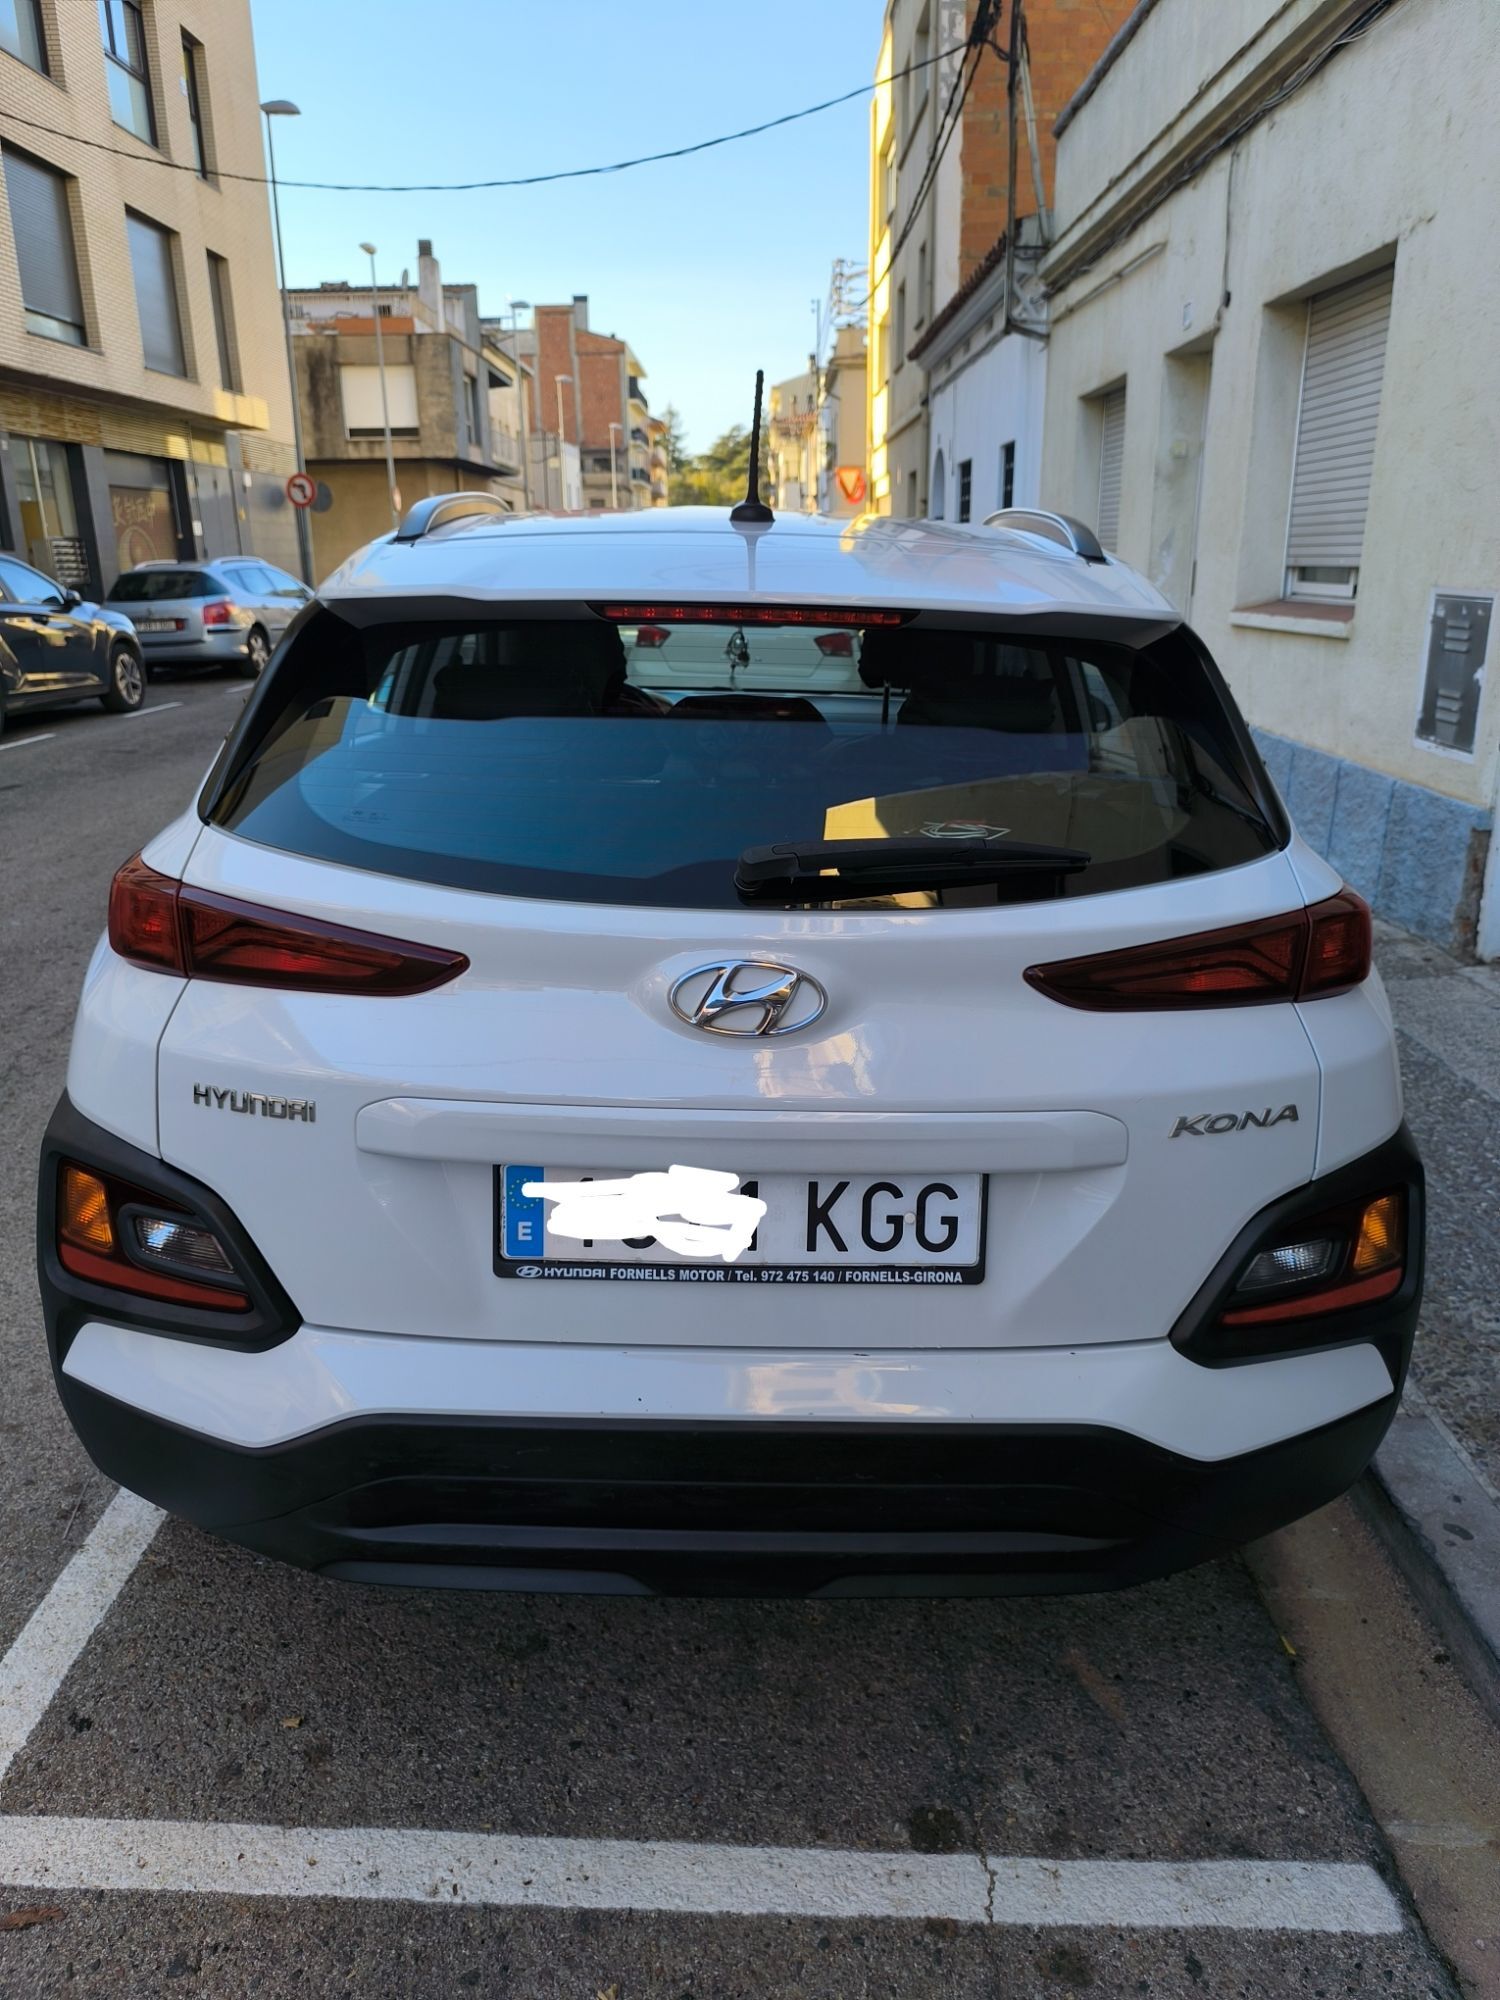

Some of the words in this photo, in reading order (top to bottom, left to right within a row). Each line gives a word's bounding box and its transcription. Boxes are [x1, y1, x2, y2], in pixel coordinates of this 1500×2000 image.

[193, 1082, 316, 1123] HYUNDAI
[1168, 1103, 1299, 1138] KONA
[517, 1221, 533, 1241] E
[806, 1181, 959, 1253] KGG
[544, 1267, 606, 1278] HYUNDAI
[610, 1268, 676, 1280] FORNELLS
[679, 1269, 725, 1281] MOTOR
[735, 1270, 757, 1281] Tel.
[761, 1270, 783, 1282] 972
[787, 1271, 809, 1282] 475
[813, 1271, 835, 1282] 140
[845, 1271, 963, 1283] FORNELLS-GIRONA
